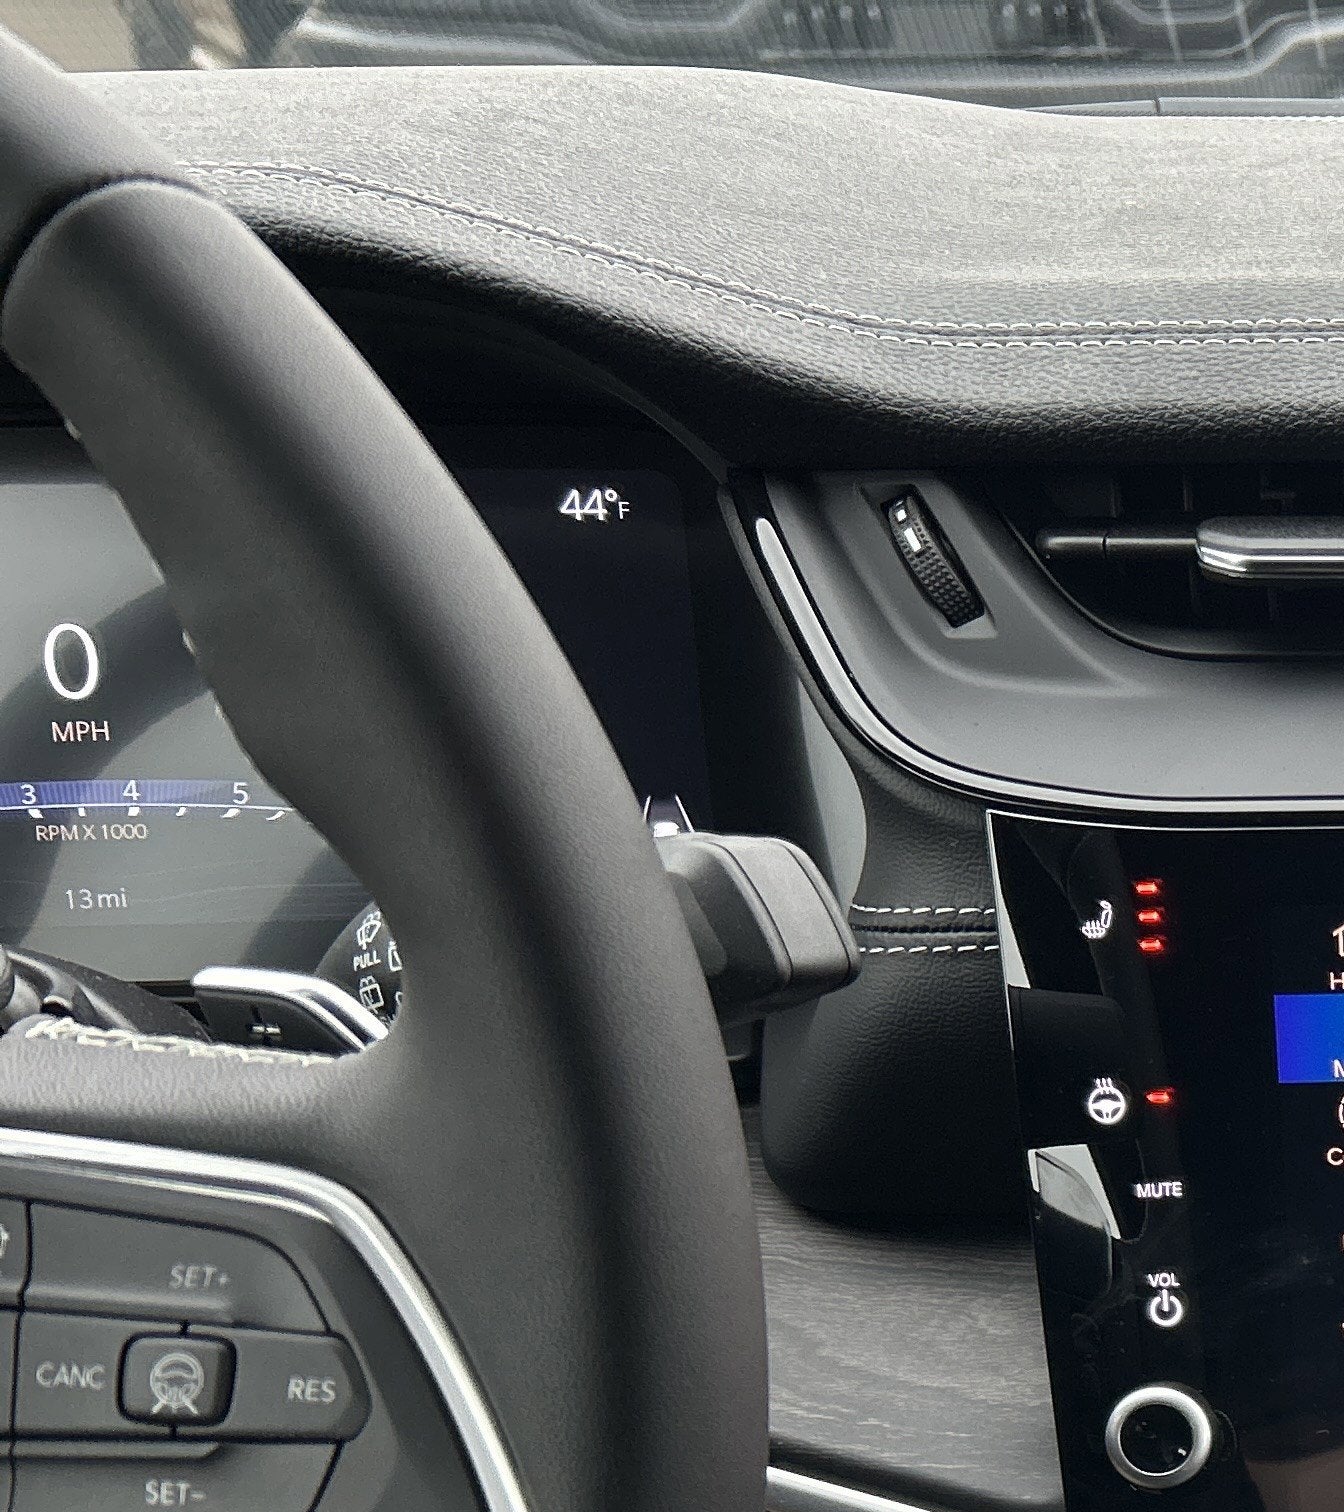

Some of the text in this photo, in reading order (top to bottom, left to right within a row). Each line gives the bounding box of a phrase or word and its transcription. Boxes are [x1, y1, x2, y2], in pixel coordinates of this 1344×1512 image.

[45, 623, 99, 699] 0
[51, 721, 111, 743] MPH
[21, 779, 249, 804] 3 4 5
[35, 824, 81, 842] RPM
[102, 823, 148, 841] 1000
[65, 887, 127, 910] 13 mi
[353, 950, 381, 972] PULL
[1135, 1182, 1183, 1199] MUTE
[169, 1264, 229, 1291] SET+
[1147, 1273, 1180, 1288] VOL
[35, 1361, 105, 1391] CANC
[287, 1377, 336, 1404] RES
